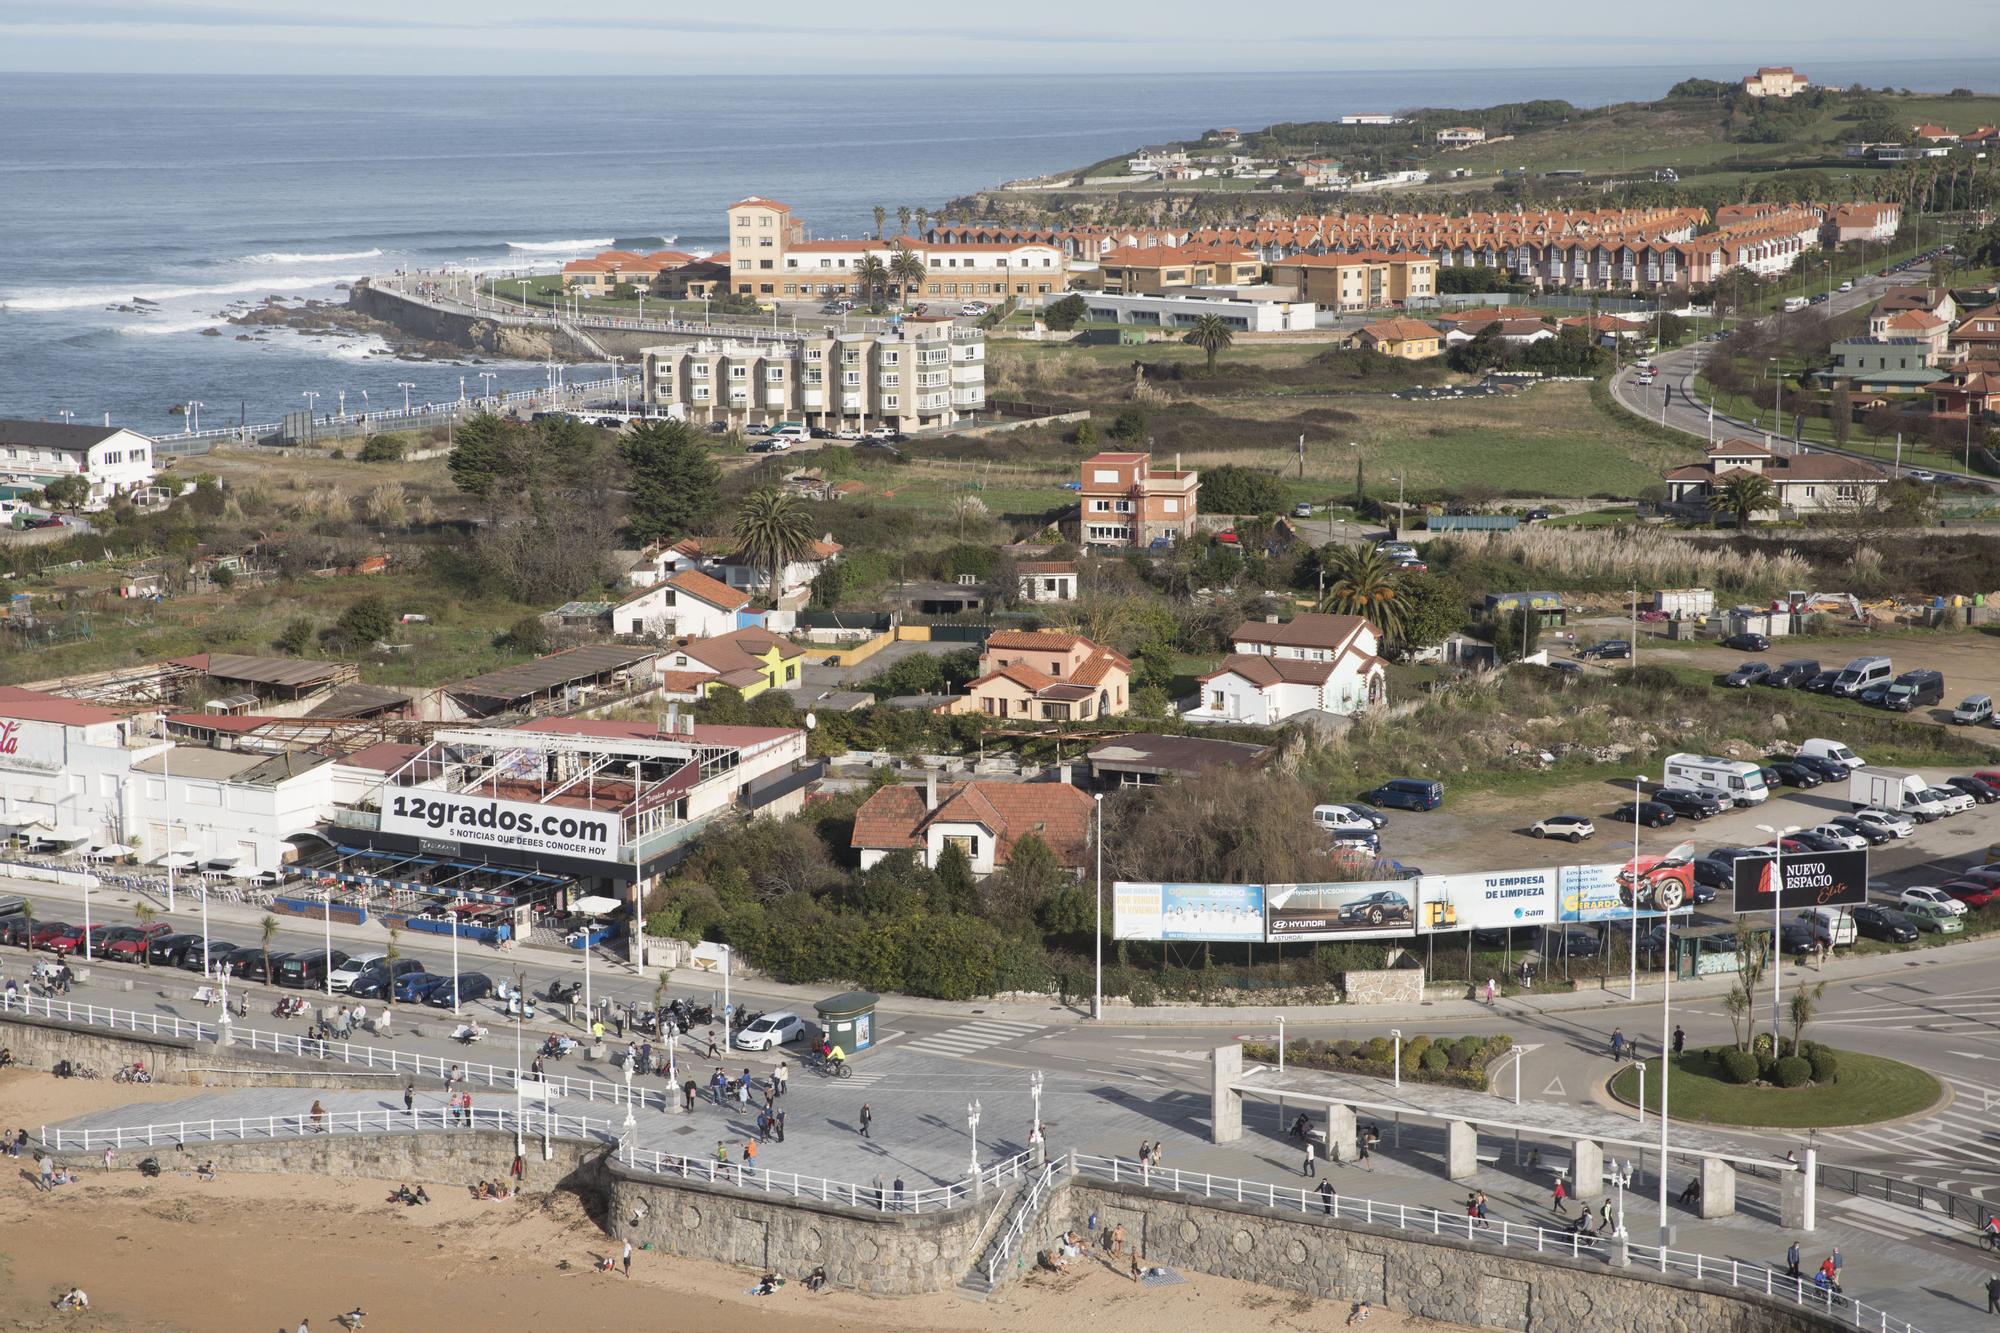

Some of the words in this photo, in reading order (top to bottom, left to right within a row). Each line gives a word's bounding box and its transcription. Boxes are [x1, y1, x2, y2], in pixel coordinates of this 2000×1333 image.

[393, 796, 607, 842] 12grados.com
[457, 829, 495, 841] NOTICIAS
[498, 835, 514, 844] QUE
[516, 837, 544, 848] DEBES
[546, 840, 586, 853] CONOCER
[588, 847, 607, 856] HOY
[1786, 863, 1825, 876] NUEVO
[1485, 879, 1497, 887] TU
[1499, 876, 1544, 886] EMPRESA
[1786, 874, 1832, 889] ESPACIO
[1485, 891, 1498, 899] DE
[1500, 888, 1544, 898] LIMPIEZA
[1524, 909, 1544, 917] sam
[549, 1087, 558, 1096] 16
